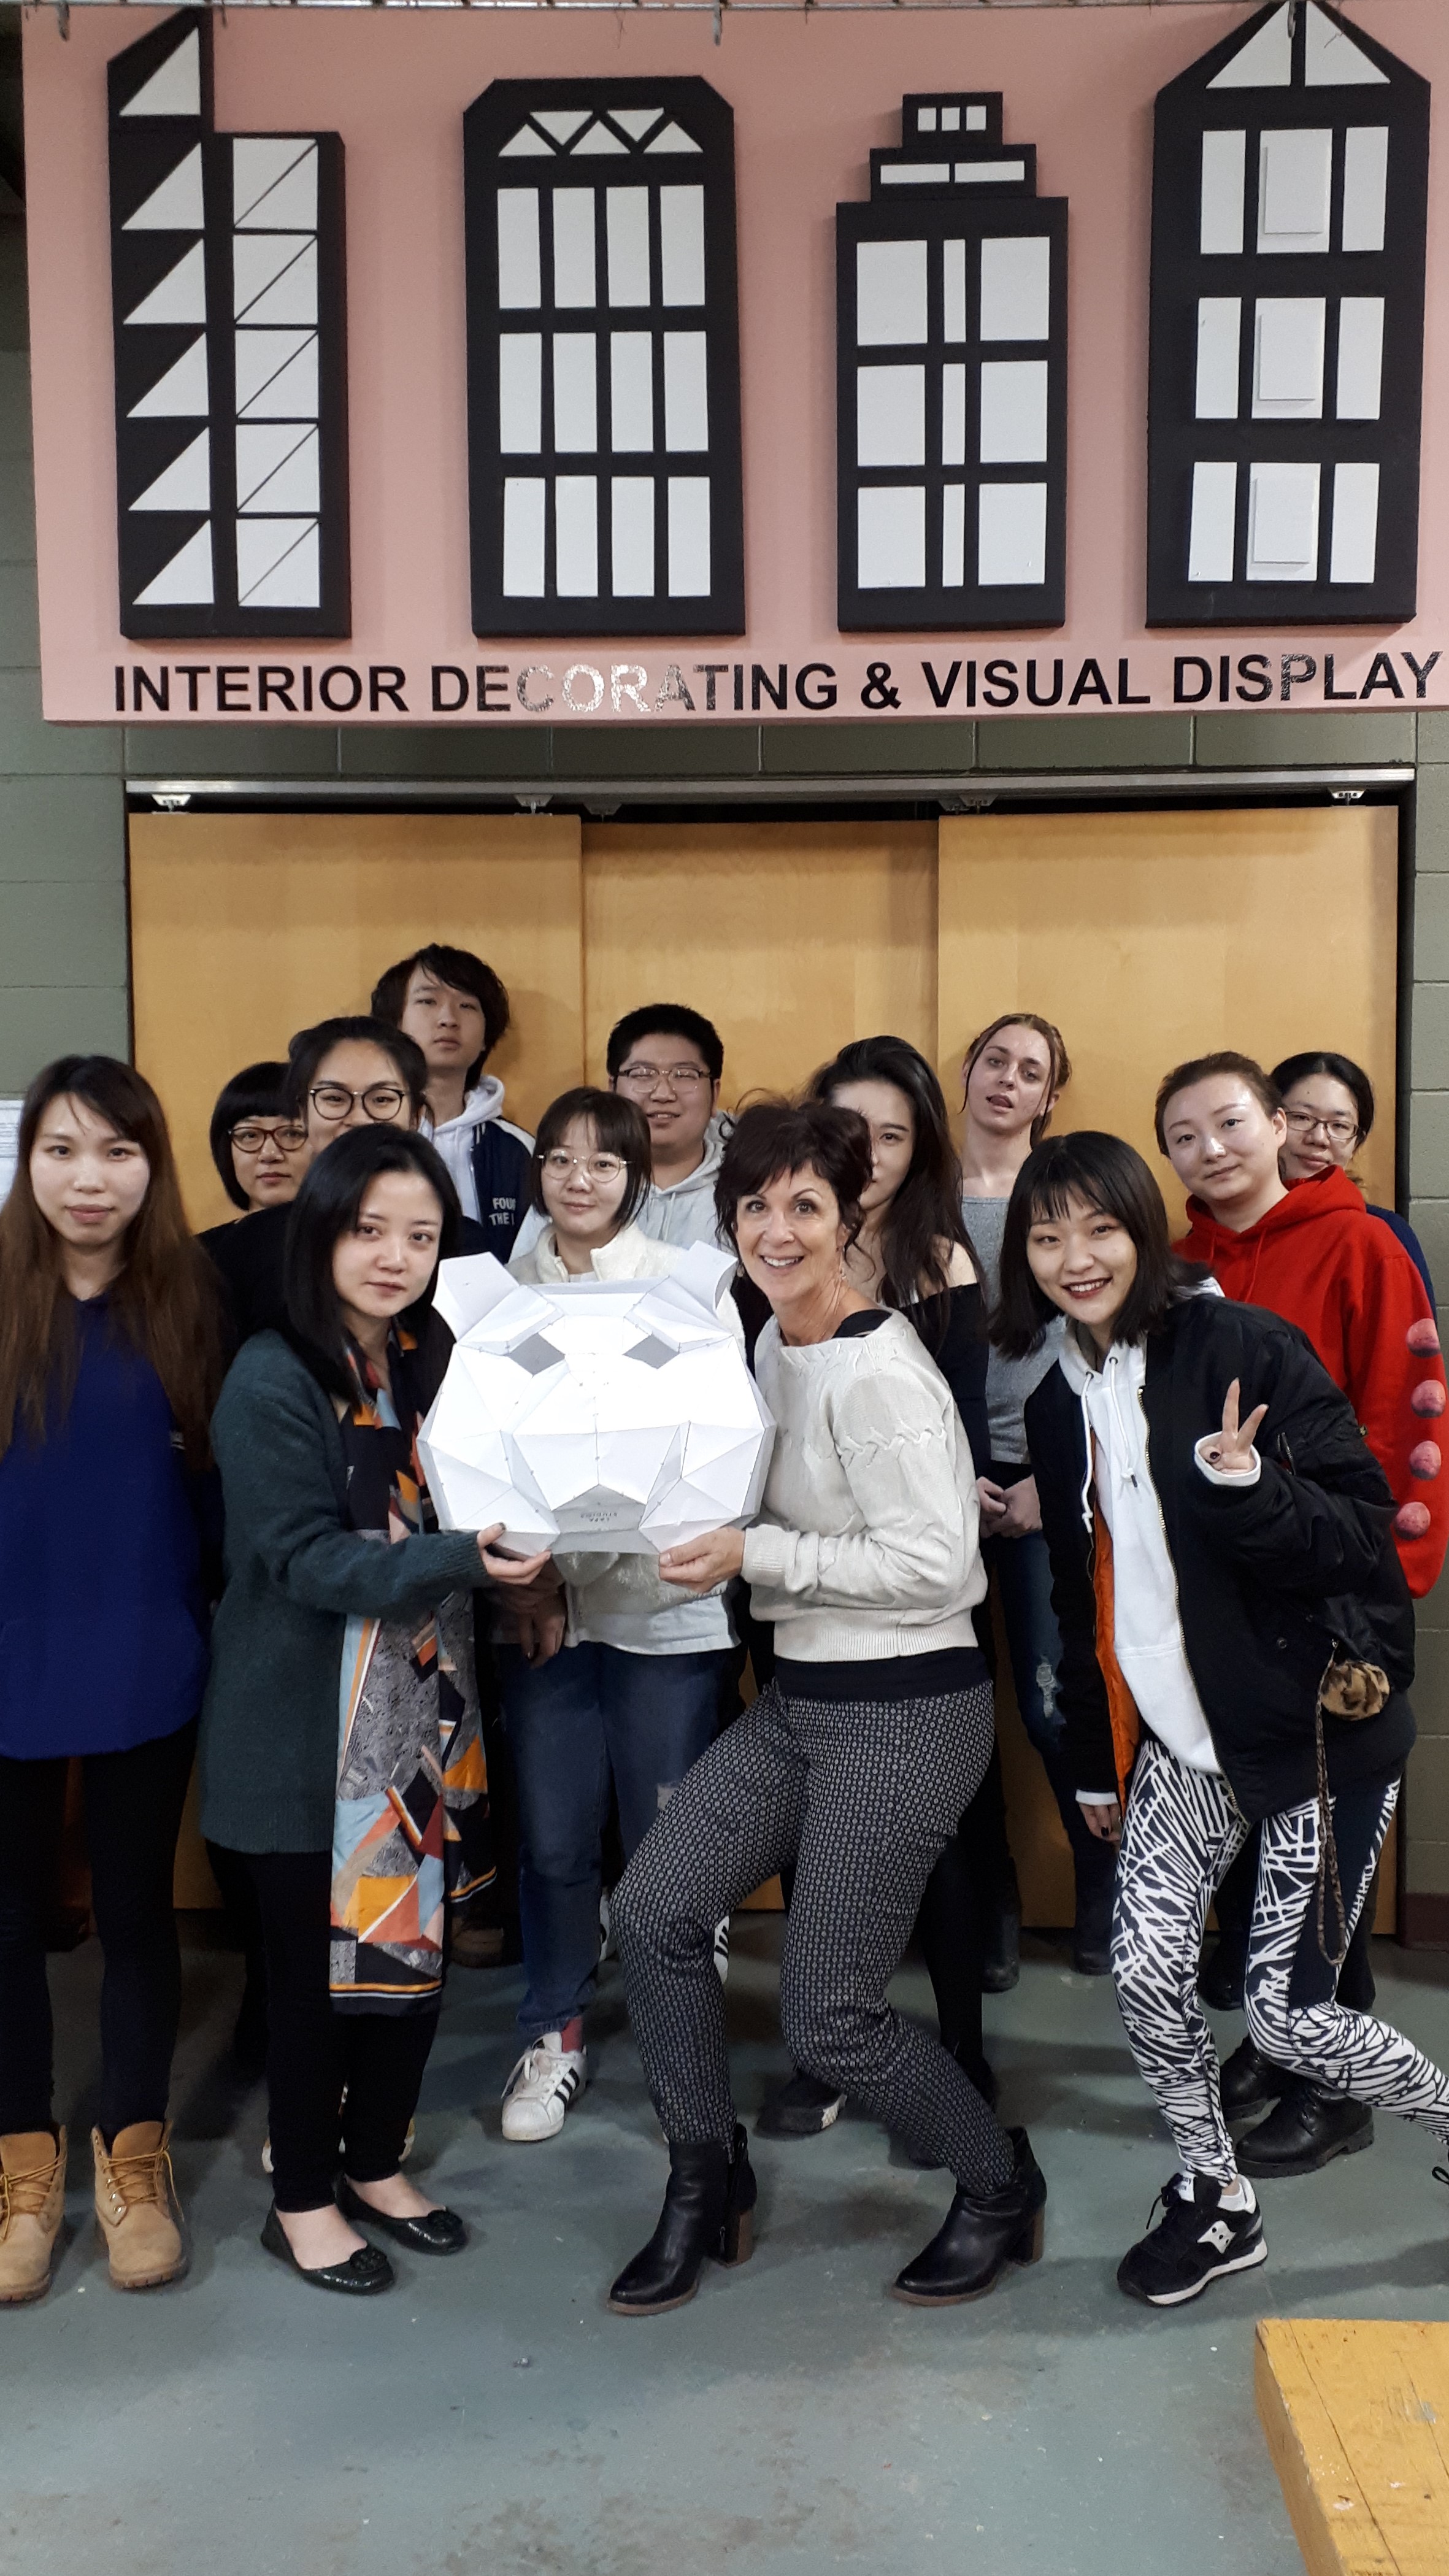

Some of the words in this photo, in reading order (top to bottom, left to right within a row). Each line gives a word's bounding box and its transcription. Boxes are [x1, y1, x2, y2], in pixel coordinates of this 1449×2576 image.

[115, 665, 409, 712] INTERIOR
[431, 663, 837, 713] DECORATING
[861, 662, 902, 710] &
[921, 658, 1151, 708] VISUAL
[1173, 651, 1443, 703] DISPLAY
[488, 1212, 510, 1226] THE
